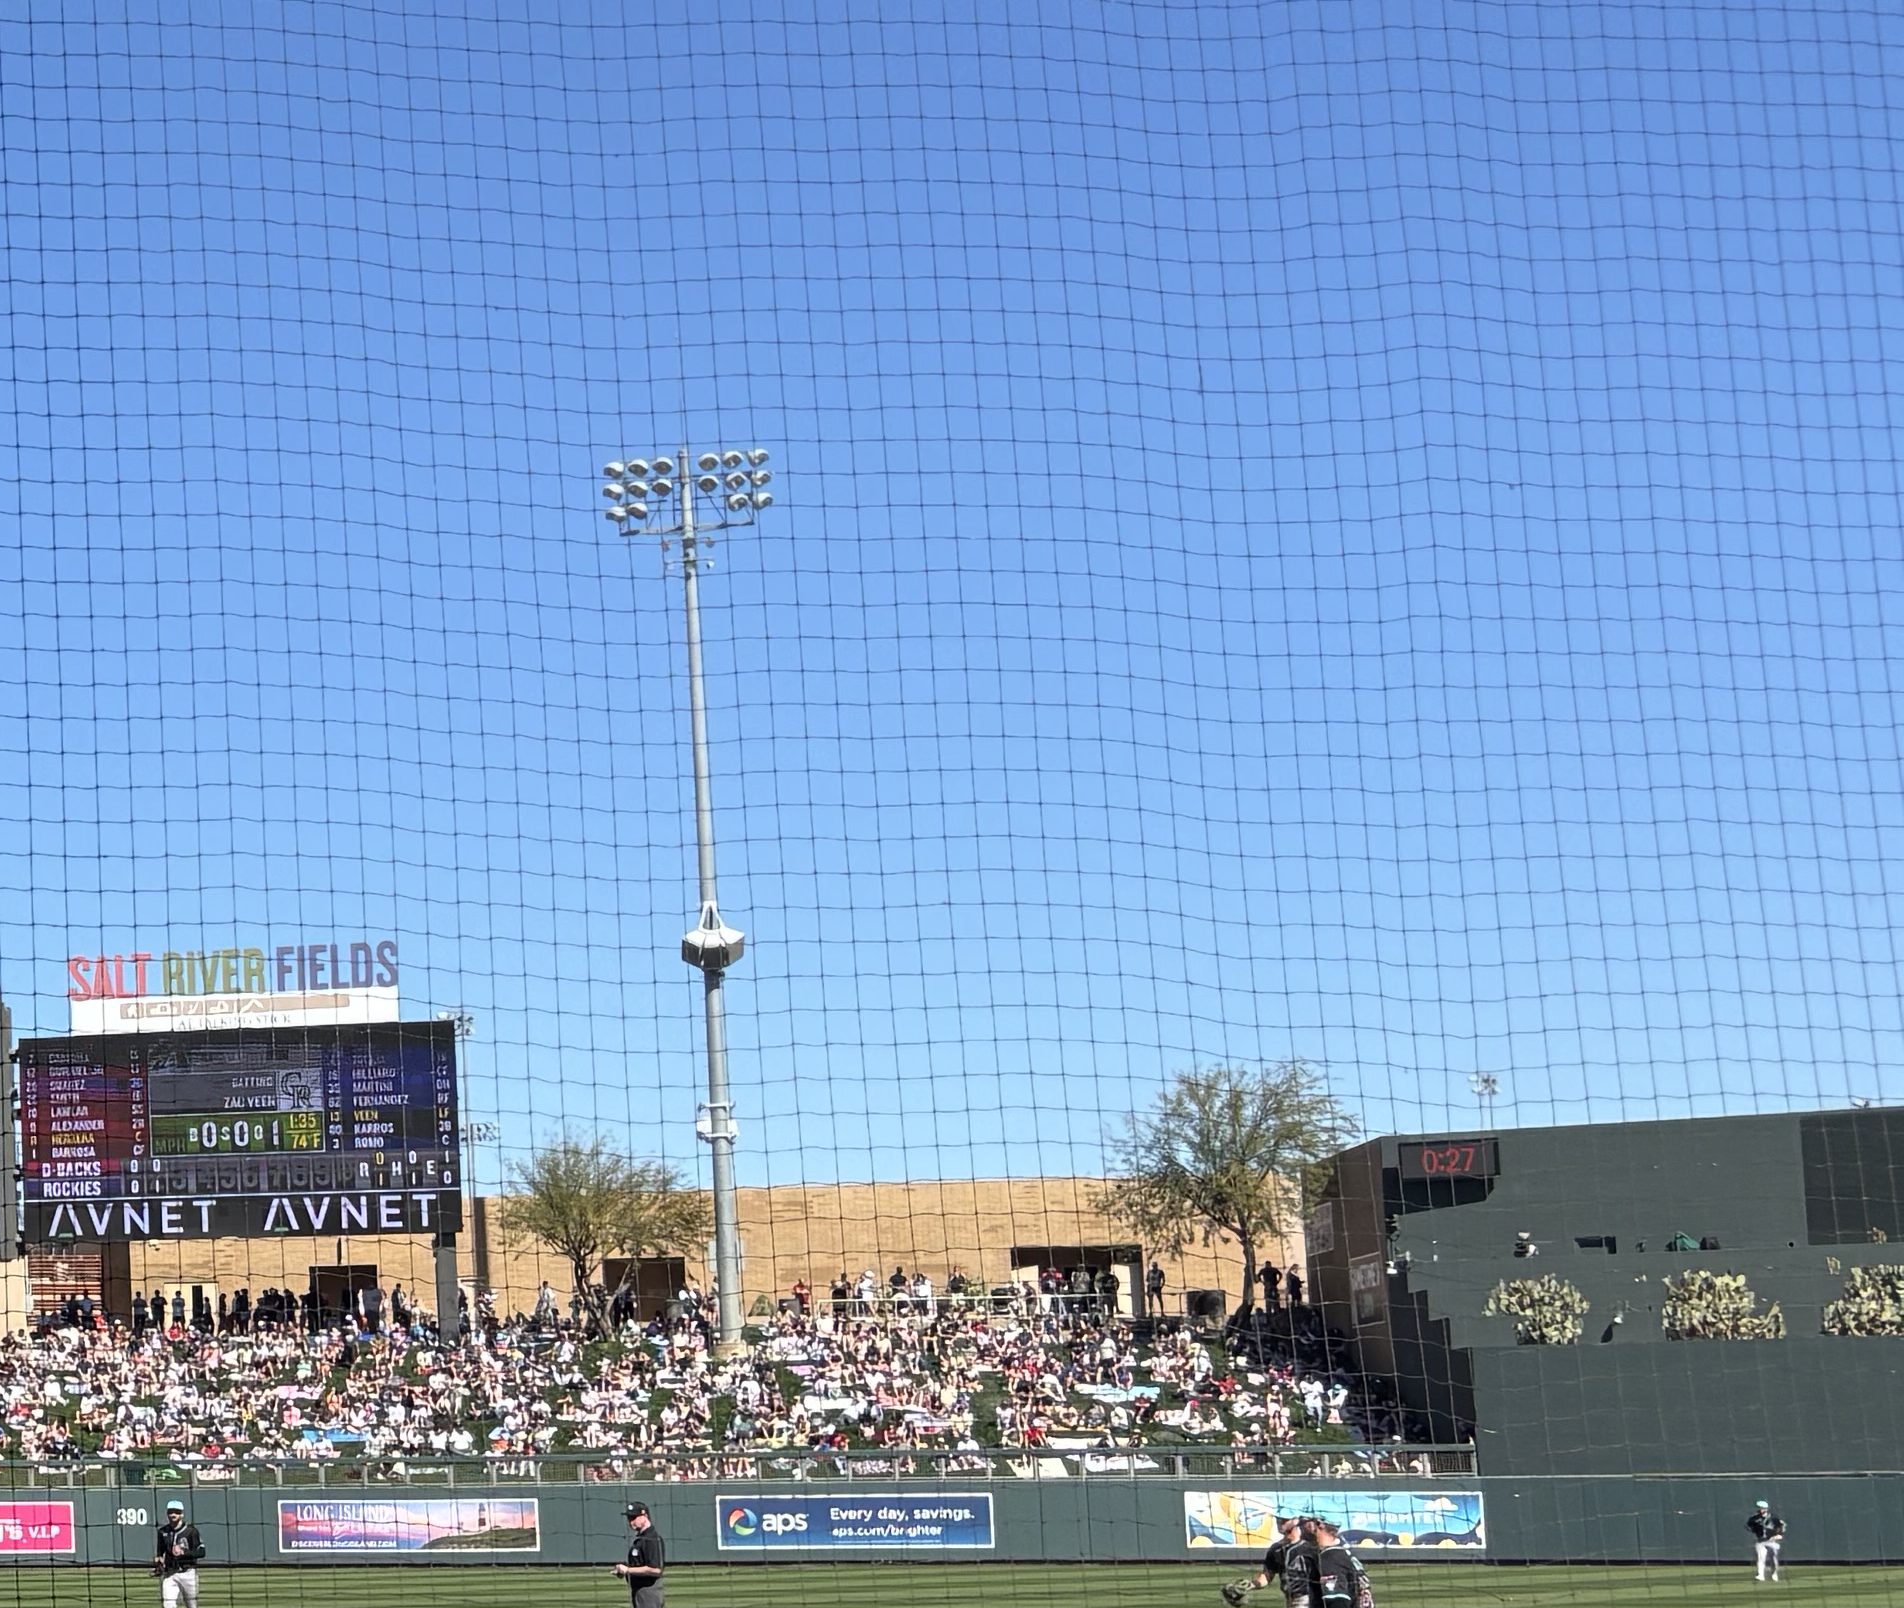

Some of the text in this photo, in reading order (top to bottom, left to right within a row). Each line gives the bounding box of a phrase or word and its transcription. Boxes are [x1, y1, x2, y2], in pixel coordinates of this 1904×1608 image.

[67, 941, 398, 1001] SALT RIVER FIELDS
[290, 1114, 316, 1128] 1:35
[202, 1122, 217, 1147] 0
[221, 1127, 231, 1140] S
[234, 1121, 249, 1146] 0
[272, 1120, 279, 1146] 1
[42, 1161, 101, 1177] D-BACKS
[360, 1162, 369, 1177] R
[393, 1161, 401, 1176] H
[427, 1159, 435, 1175] E
[1421, 1148, 1475, 1174] 0:27
[44, 1181, 101, 1197] ROCKIES
[48, 1194, 437, 1237] AVNET AVNET
[117, 1508, 148, 1525] 390
[296, 1504, 334, 1521] LONG
[830, 1506, 975, 1523] Every day, savings.
[762, 1512, 807, 1535] aps
[832, 1524, 943, 1537] aps.com/brighter
